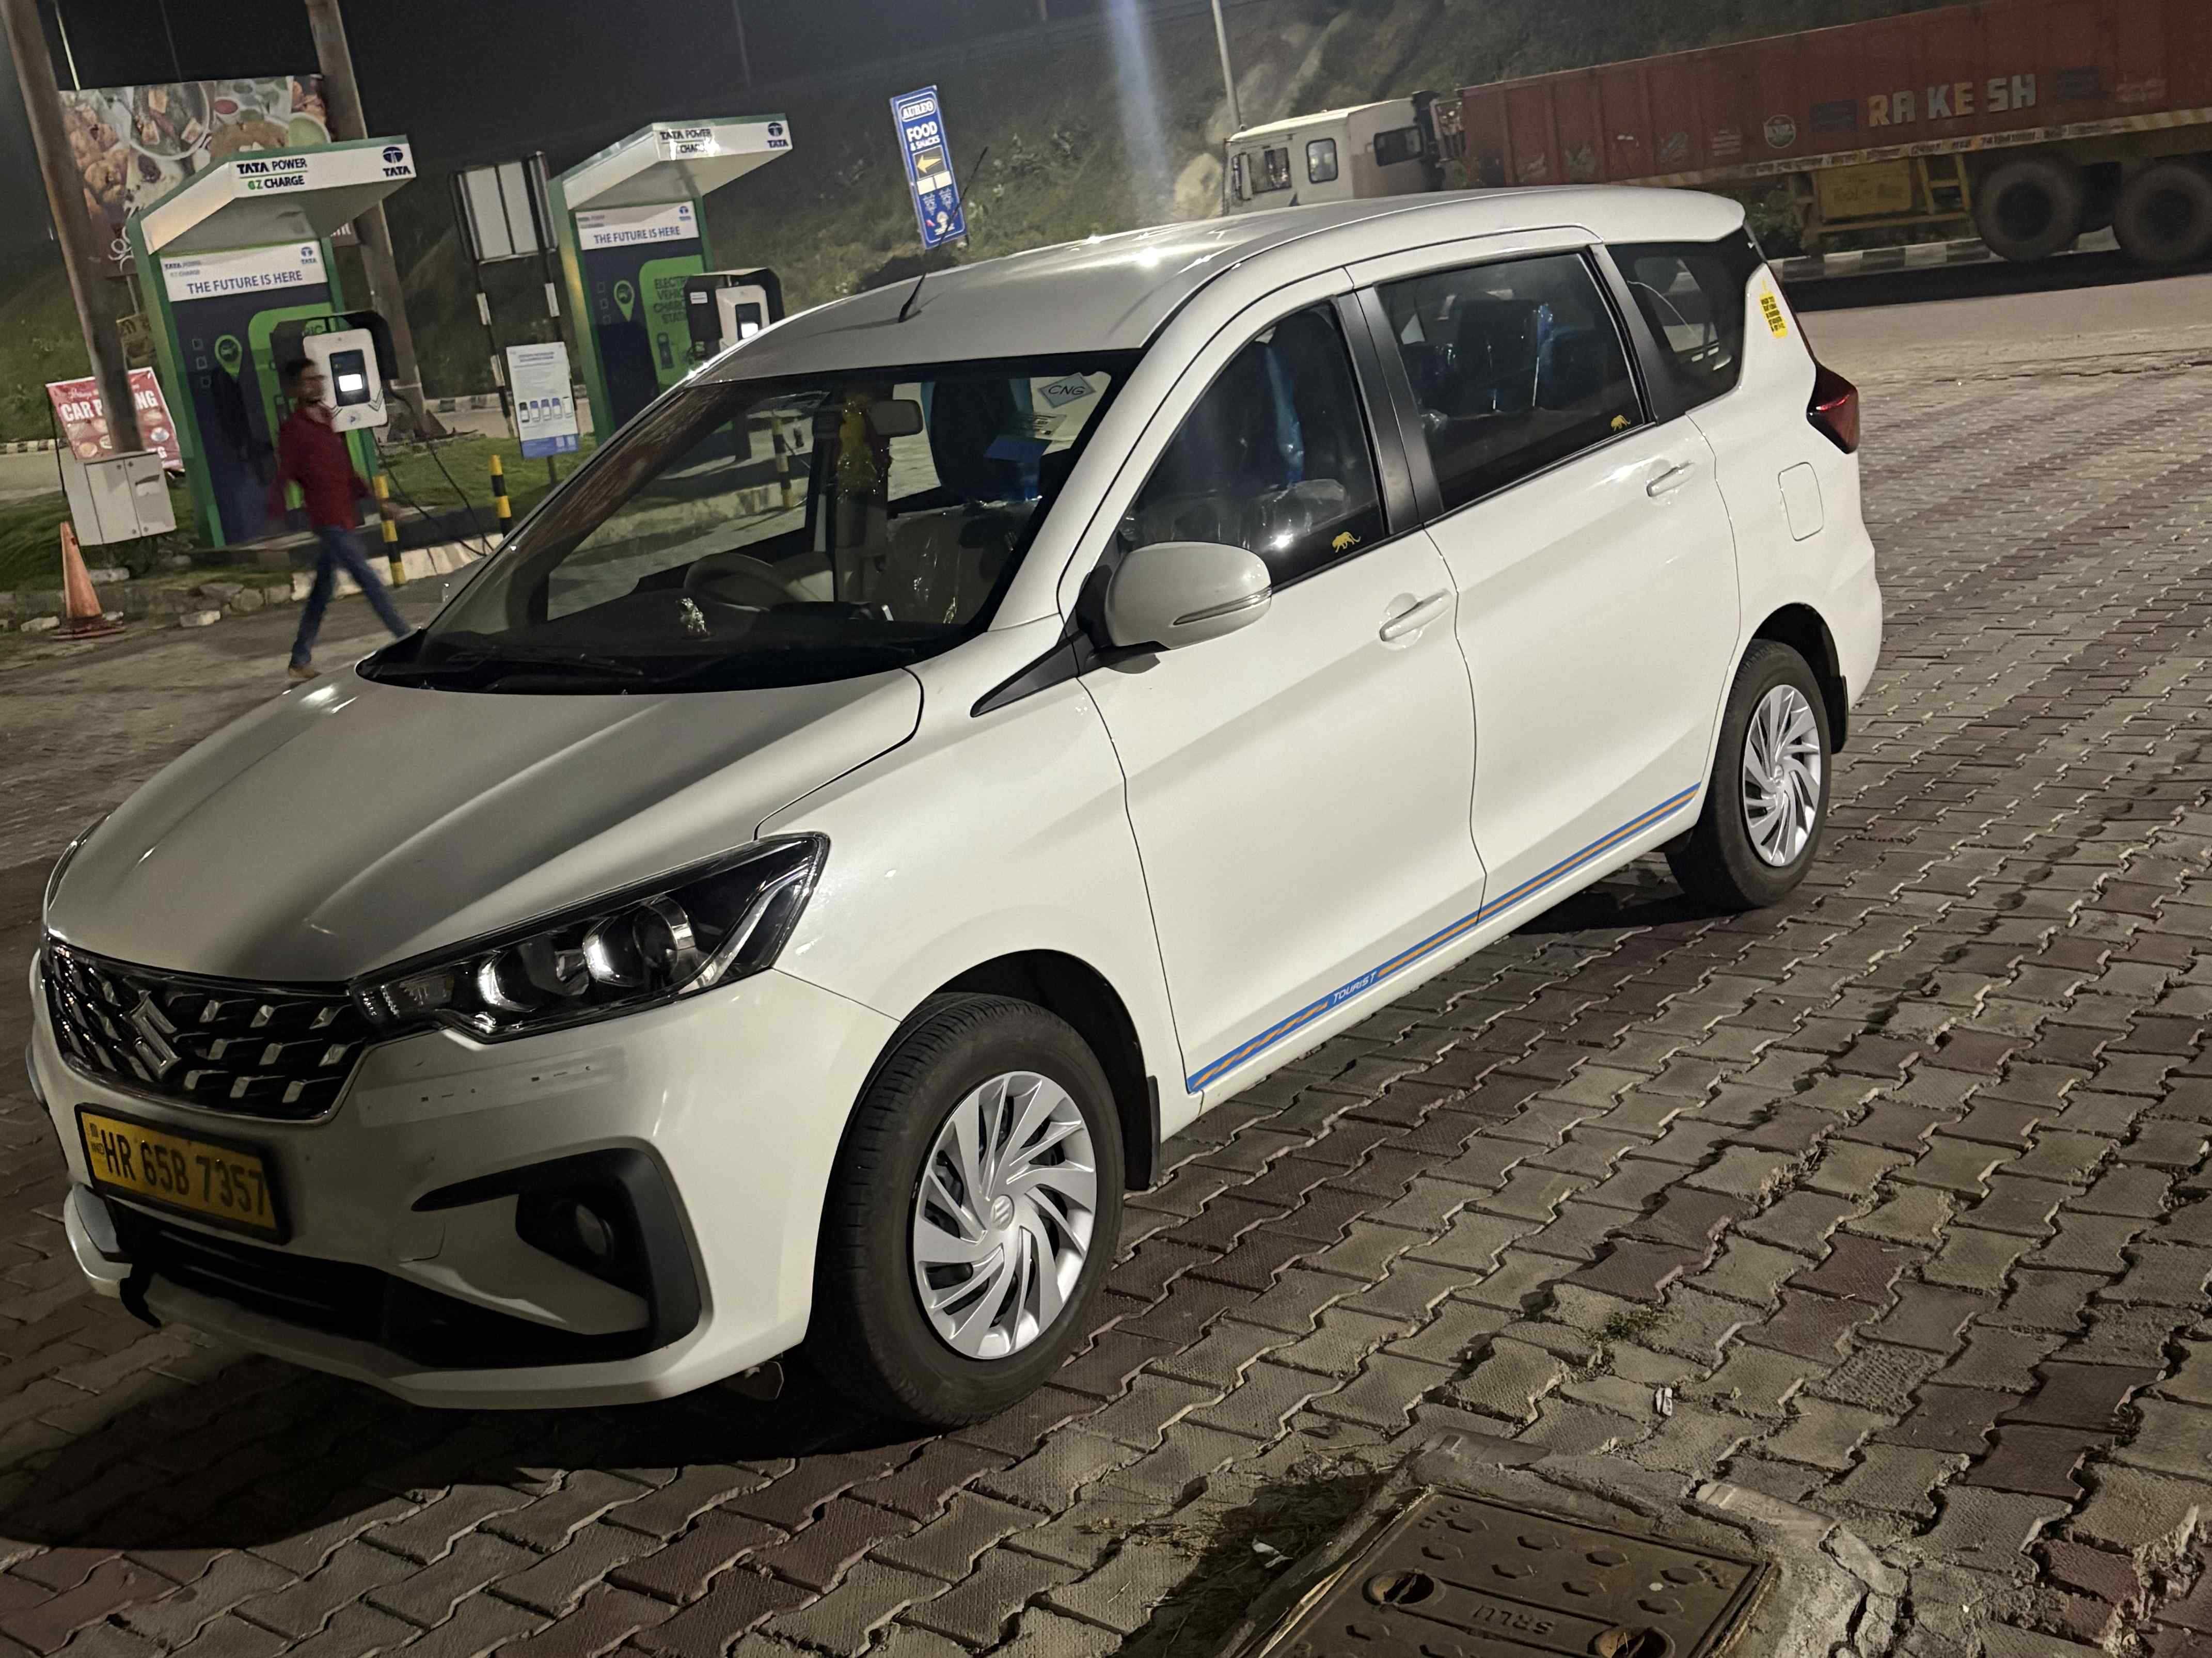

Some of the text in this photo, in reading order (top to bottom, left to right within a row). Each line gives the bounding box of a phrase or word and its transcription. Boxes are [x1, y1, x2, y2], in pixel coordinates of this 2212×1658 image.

[659, 128, 712, 140] TATA POWER
[906, 121, 938, 142] FOOD
[767, 139, 789, 148] TATA
[236, 157, 308, 175] TATA POWER
[383, 165, 412, 177] TATA
[264, 175, 305, 188] CHARGE
[594, 226, 681, 244] THE FUTURE IS HERE
[187, 270, 303, 295] THE FUTURE IS HERE
[1048, 385, 1086, 396] CNG
[60, 401, 94, 421] CAR
[101, 1129, 264, 1215] HR 65B 7357
